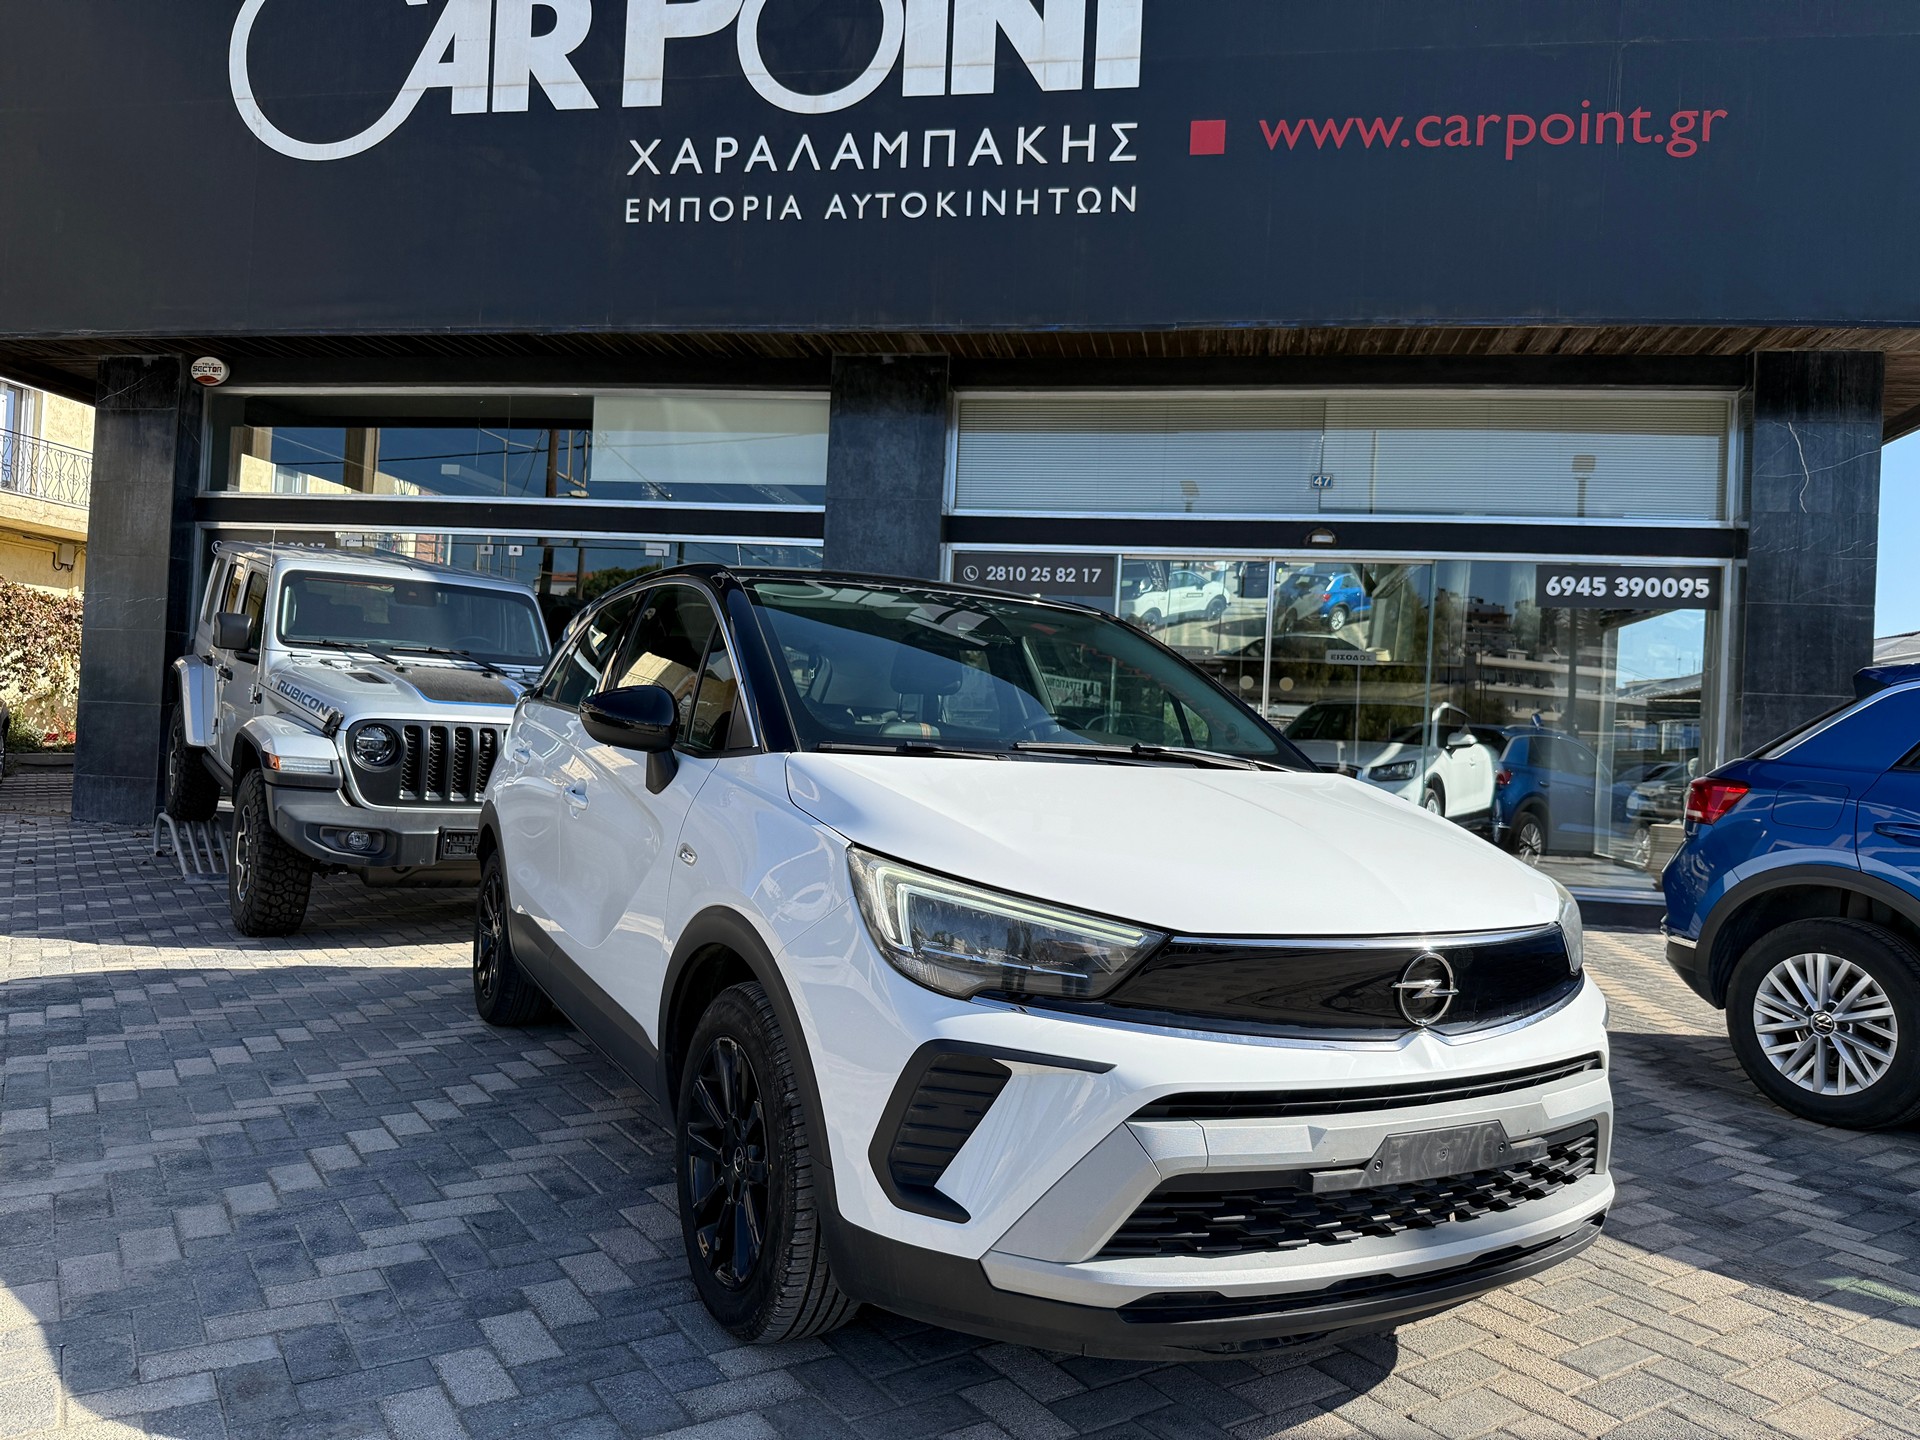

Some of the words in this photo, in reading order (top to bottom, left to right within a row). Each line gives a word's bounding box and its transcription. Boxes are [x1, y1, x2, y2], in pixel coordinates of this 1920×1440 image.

[627, 122, 1138, 175] ΧΑΡΑΛΑΜΠΑΚΗΣ
[1259, 100, 1728, 160] www.carpoint.gr
[625, 194, 802, 223] ΕΜΠΟΡΙΑ
[824, 185, 1137, 220] ΑΥΤΟΚΙΝΗΤΩΝ
[1314, 476, 1331, 487] 47
[986, 565, 1027, 582] 2810
[1031, 566, 1051, 582] 25
[1055, 567, 1076, 583] 82
[1082, 567, 1102, 583] 17
[1545, 576, 1607, 597] 6945
[1614, 576, 1710, 599] 390095
[277, 679, 331, 717] RUBICON
